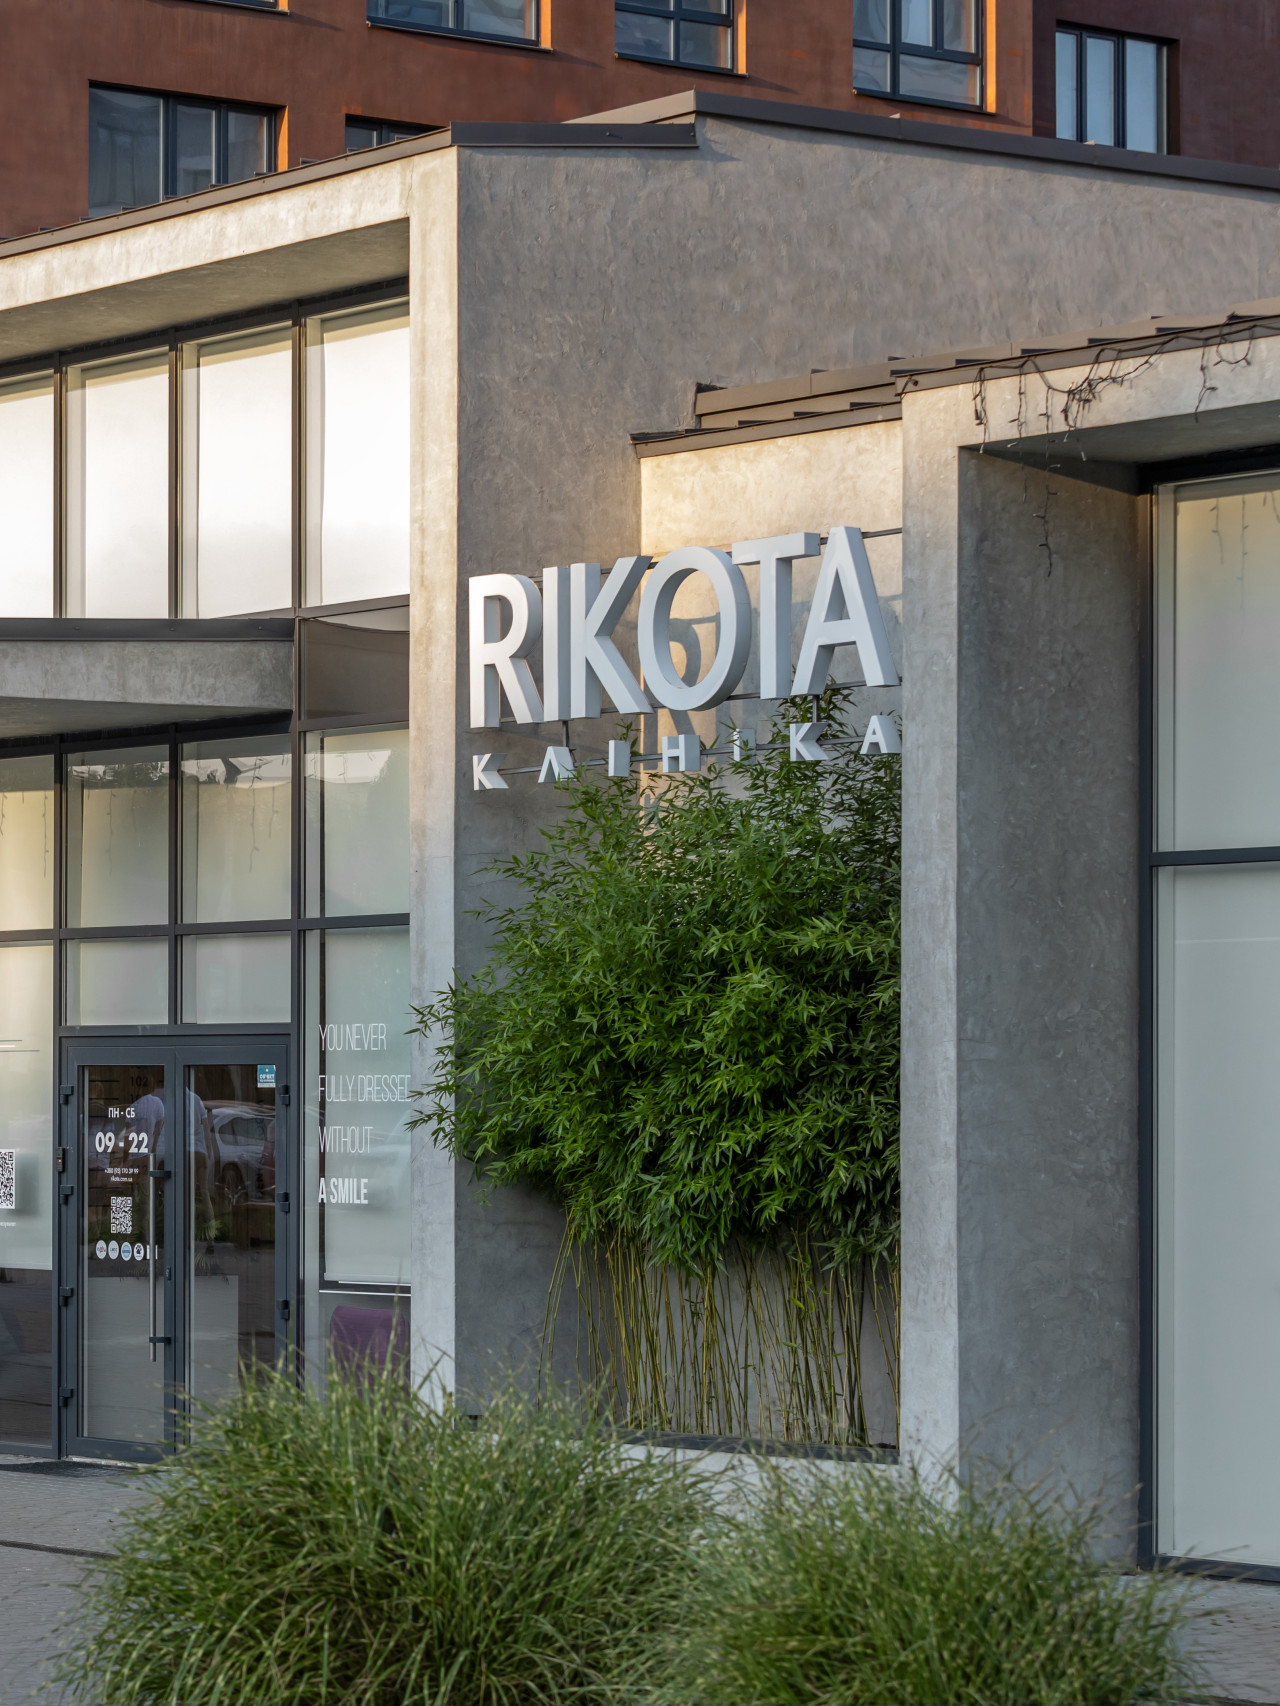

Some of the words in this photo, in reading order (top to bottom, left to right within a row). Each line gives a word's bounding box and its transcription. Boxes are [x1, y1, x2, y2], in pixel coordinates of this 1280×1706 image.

[469, 526, 900, 728] RIKOTA
[319, 1023, 342, 1051] YOU
[346, 1023, 387, 1051] NEVER
[319, 1075, 355, 1102] FULLY
[108, 1107, 120, 1118] ПН
[125, 1107, 136, 1118] СБ
[95, 1131, 115, 1153] 09
[128, 1132, 149, 1153] 22
[319, 1126, 373, 1154] WITHOUT
[318, 1177, 327, 1204] A
[330, 1177, 369, 1205] SMILE
